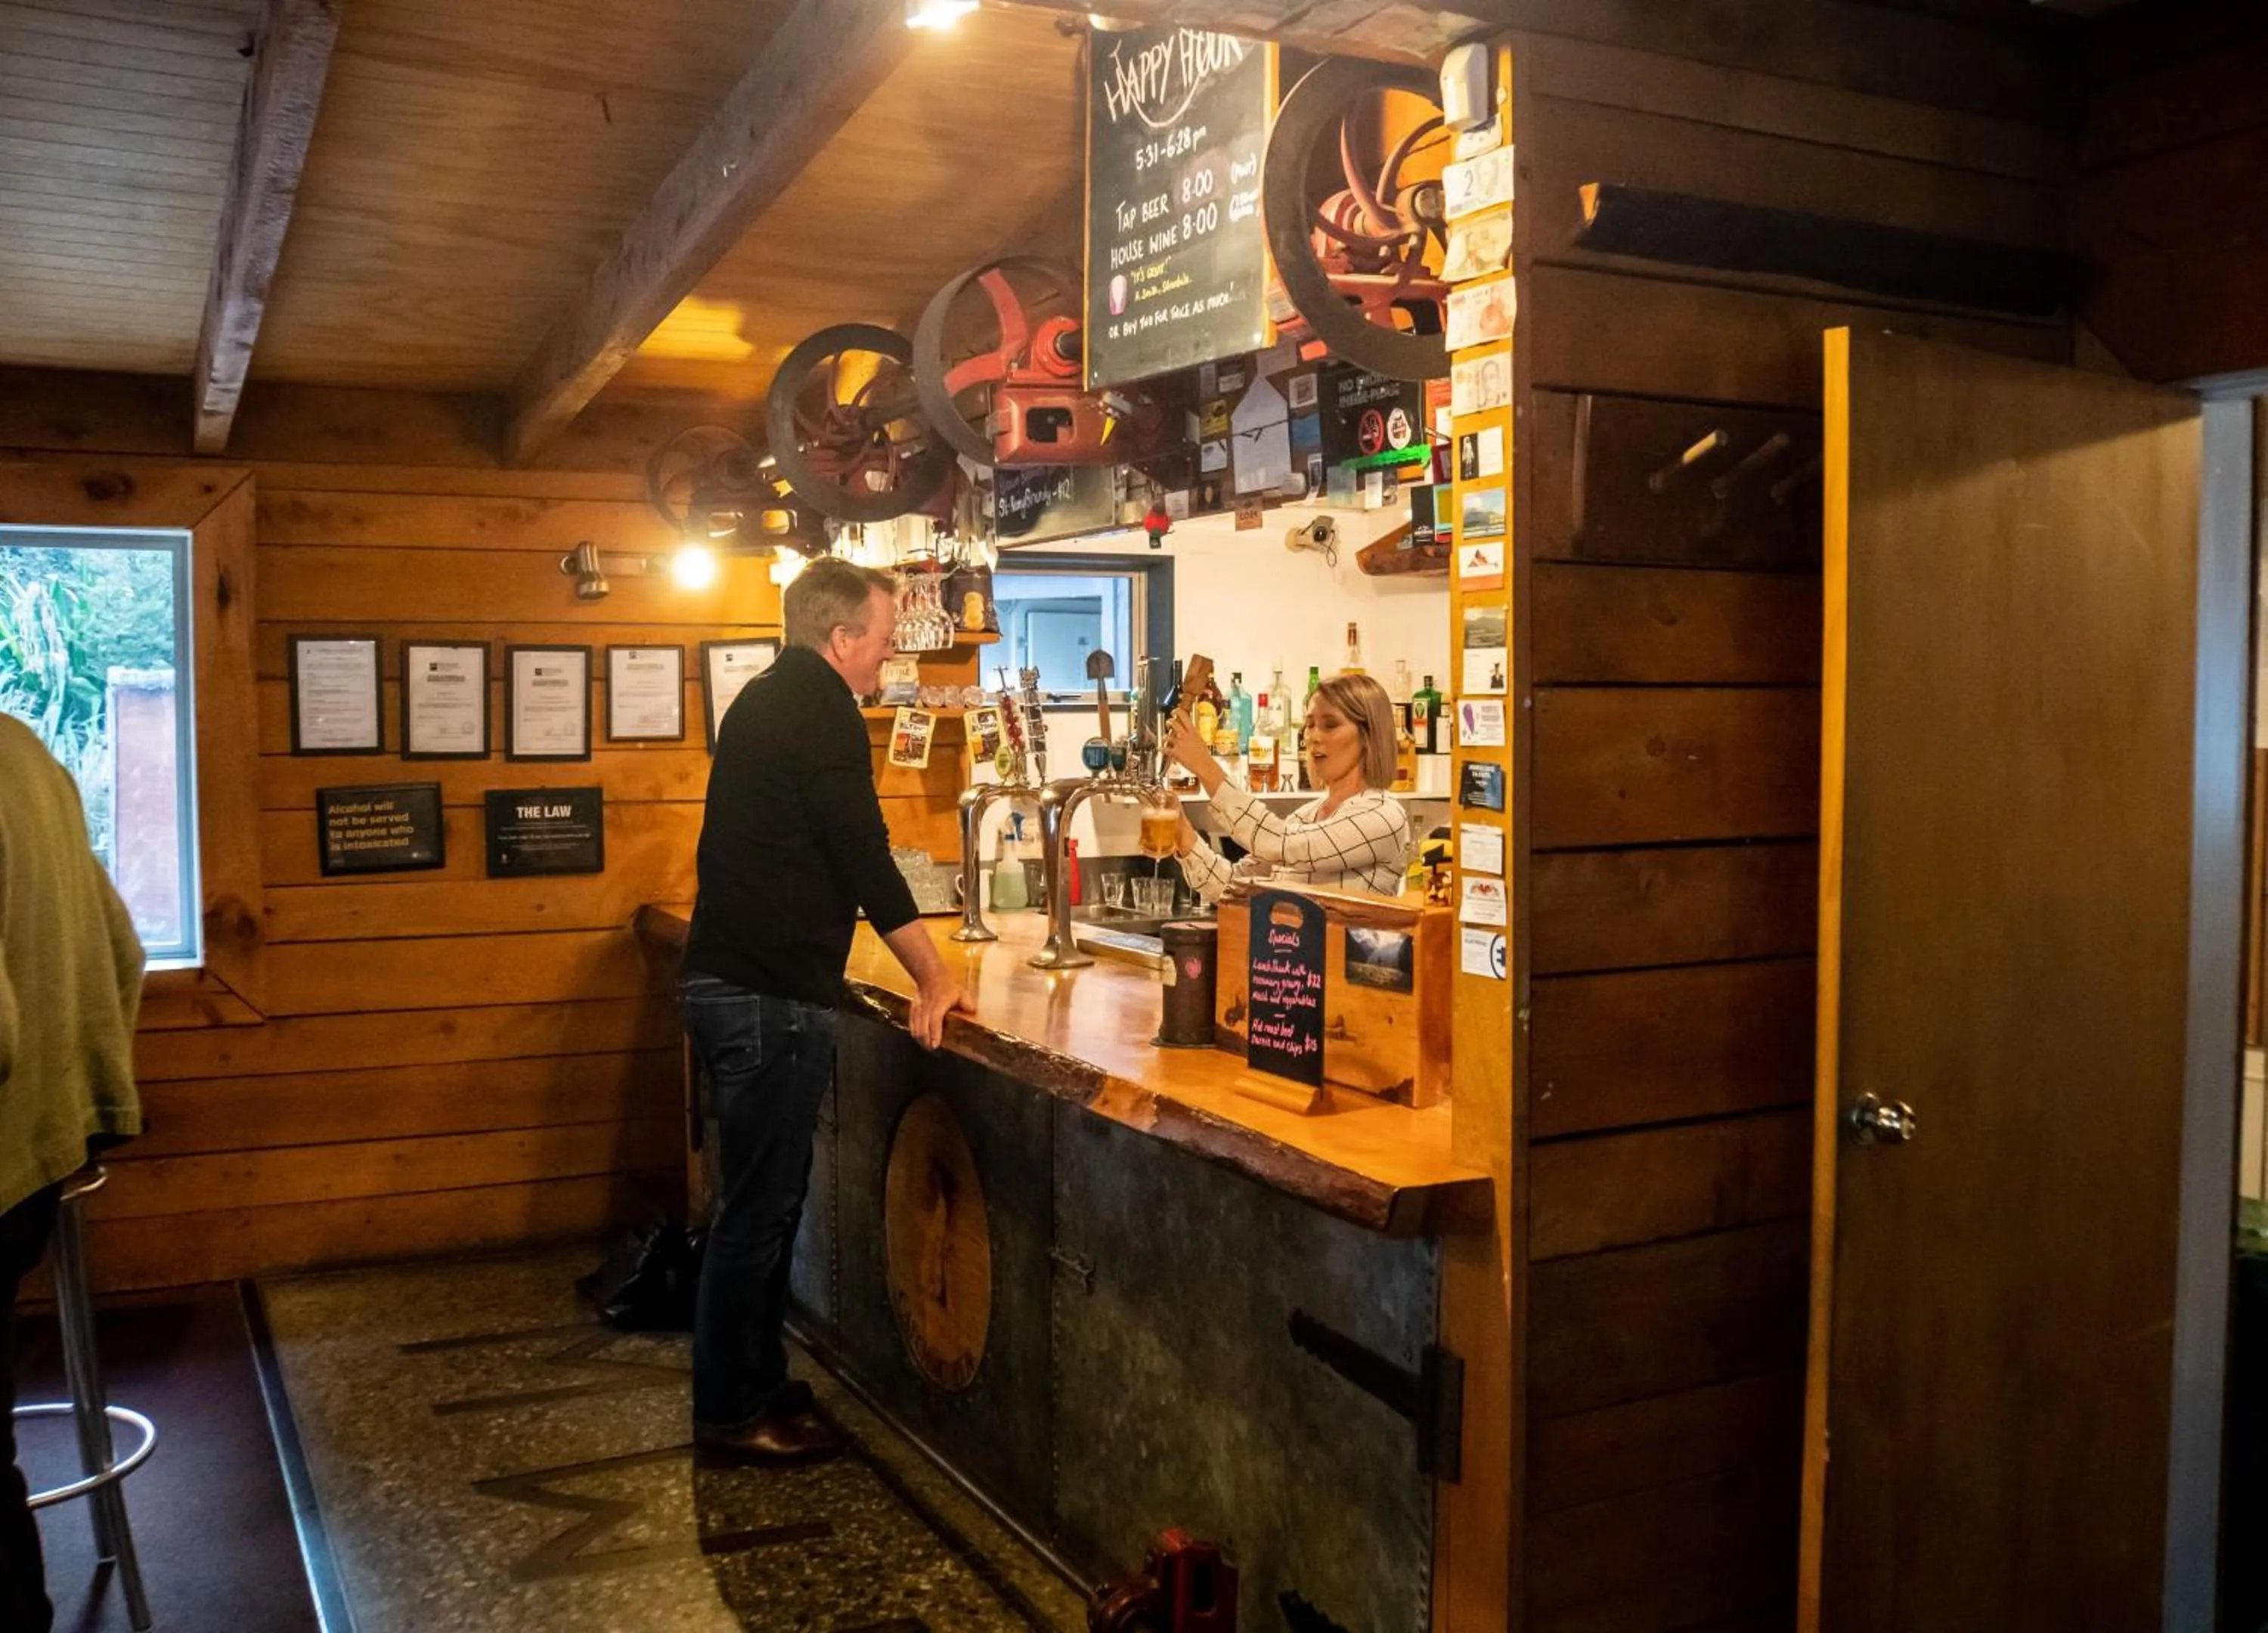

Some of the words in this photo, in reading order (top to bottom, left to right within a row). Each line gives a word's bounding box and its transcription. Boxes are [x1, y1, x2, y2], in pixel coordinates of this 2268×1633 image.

[1104, 35, 1175, 122] HAPPY
[1116, 200, 1136, 232] TAP
[1142, 194, 1170, 222] BEER
[1111, 239, 1144, 270] HOUSE
[1150, 226, 1178, 254] WINE
[1192, 298, 1206, 315] AS
[329, 804, 371, 814] Alcohol
[374, 801, 394, 811] will
[516, 806, 542, 819] THE
[544, 804, 572, 817] LAW
[329, 818, 349, 826] not
[351, 816, 367, 826] be
[370, 812, 410, 823] served
[345, 828, 387, 839] anyone
[390, 826, 414, 835] who
[344, 837, 409, 850] intoxicated
